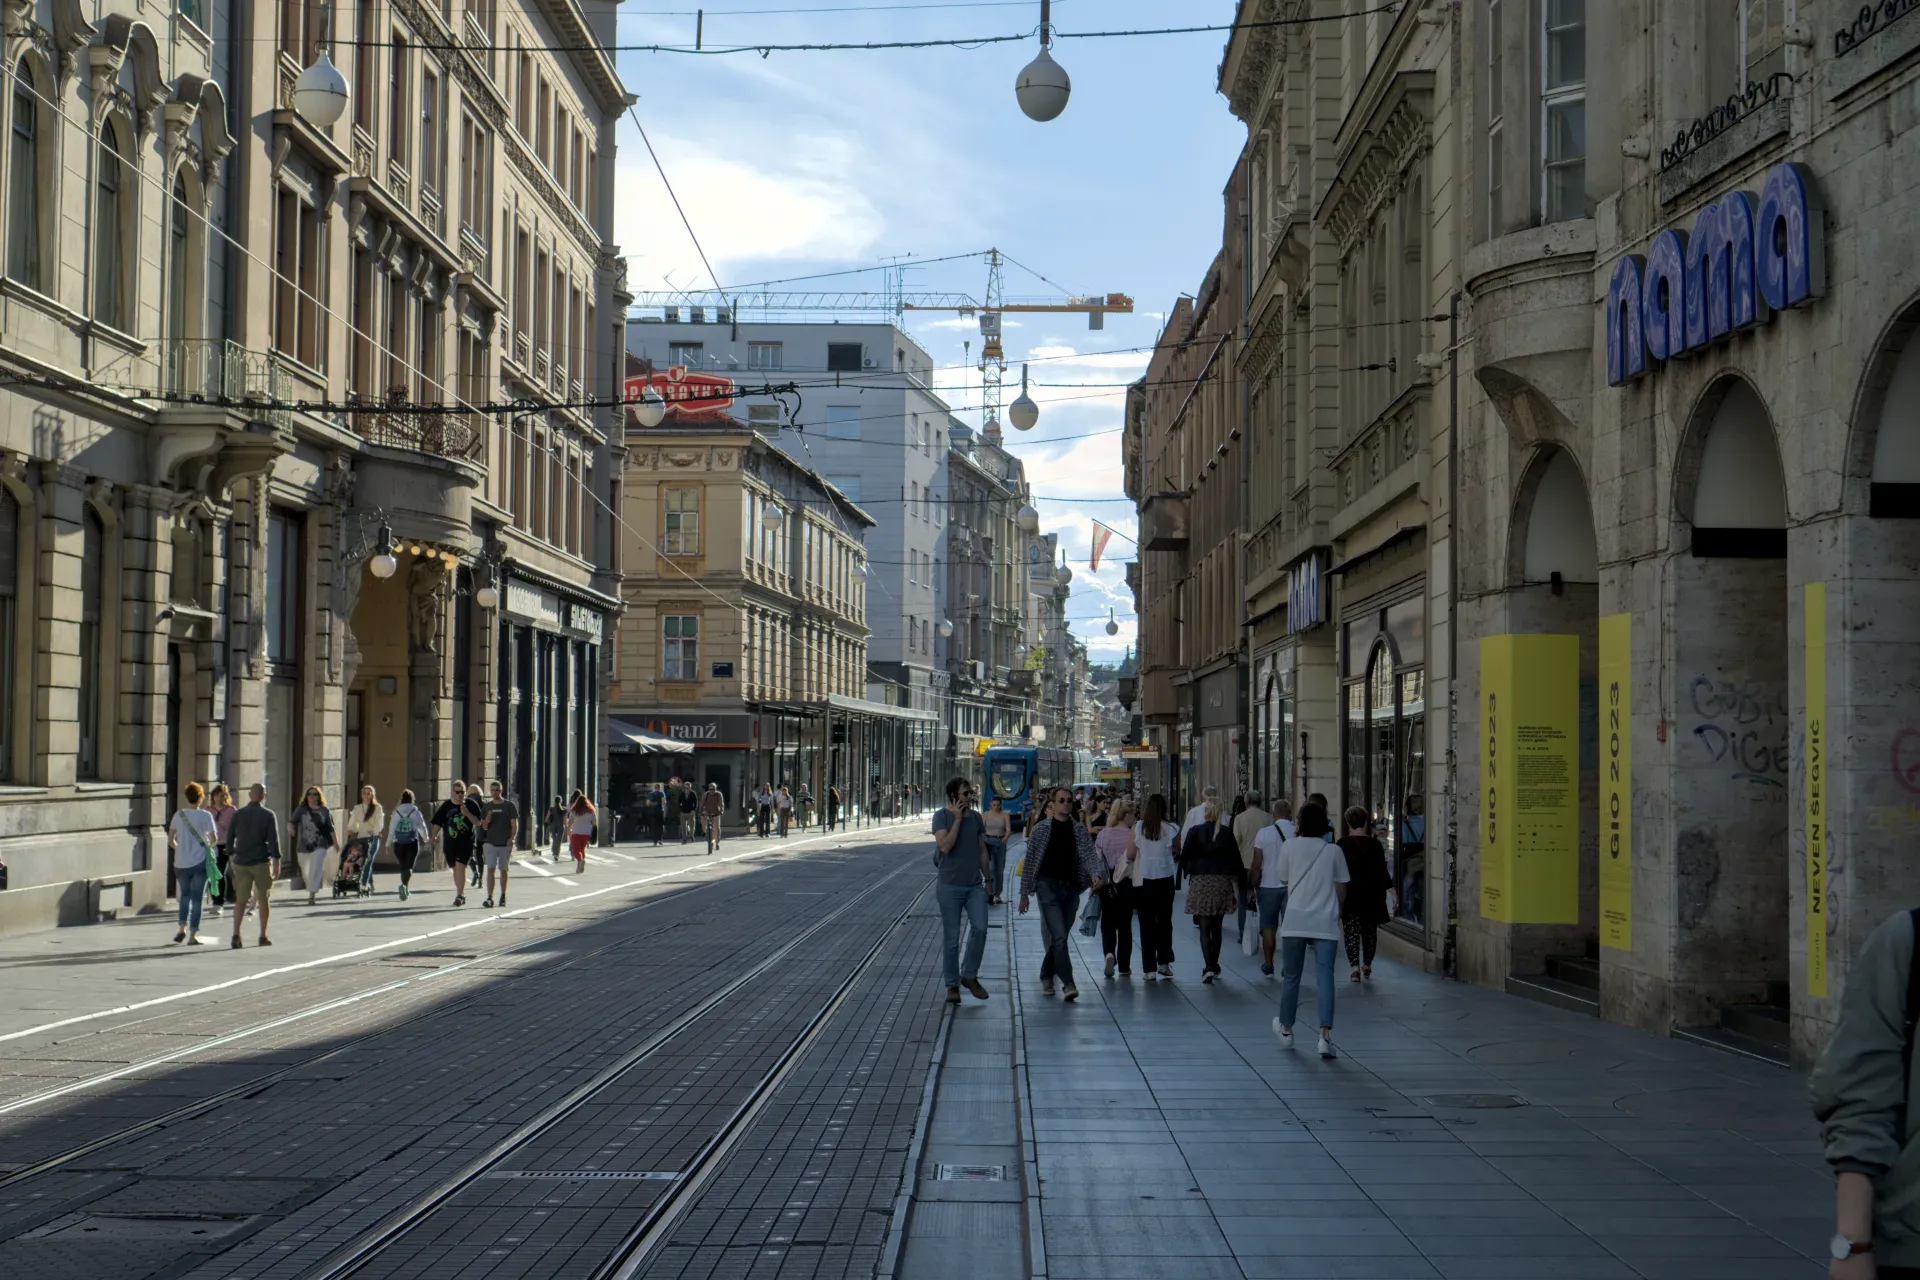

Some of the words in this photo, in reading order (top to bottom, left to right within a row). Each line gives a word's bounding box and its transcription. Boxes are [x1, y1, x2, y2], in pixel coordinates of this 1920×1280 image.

[1607, 162, 1822, 387] nama
[1488, 692, 1497, 779] 2023
[1610, 680, 1620, 783] 2023
[1809, 718, 1820, 817] ŠEGVIĆ
[1488, 787, 1497, 845] GIO
[1610, 791, 1620, 860] GIO
[1812, 823, 1821, 914] NEVEN
